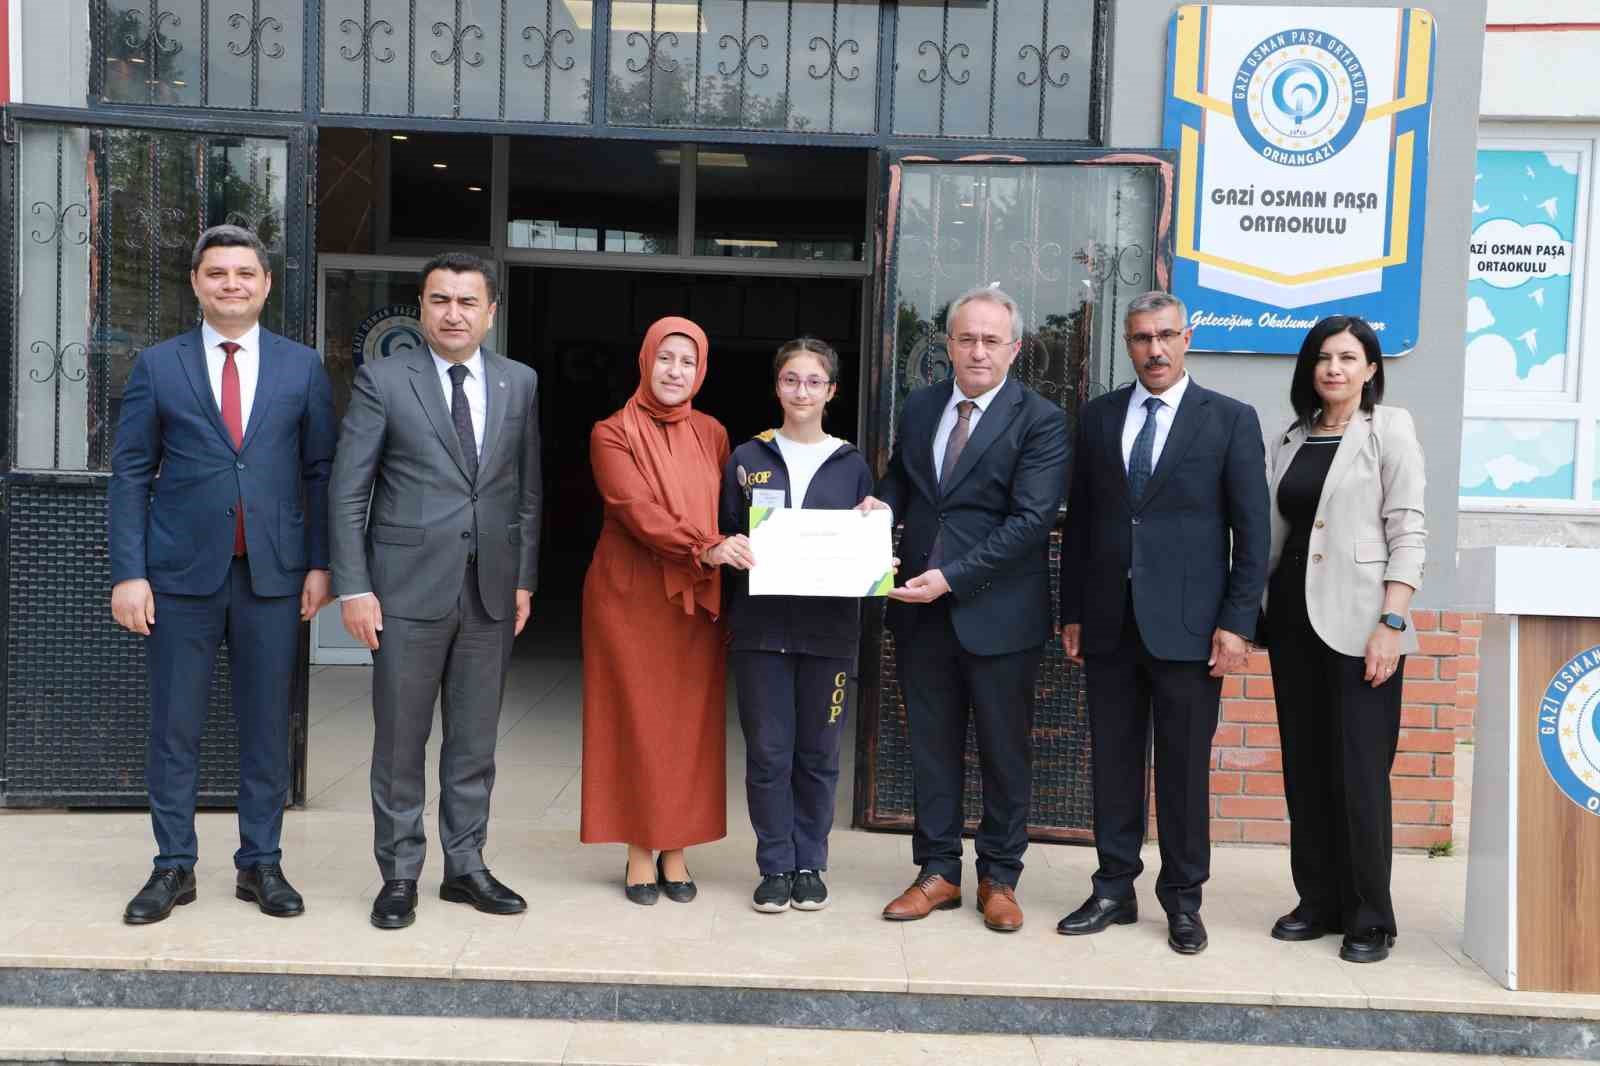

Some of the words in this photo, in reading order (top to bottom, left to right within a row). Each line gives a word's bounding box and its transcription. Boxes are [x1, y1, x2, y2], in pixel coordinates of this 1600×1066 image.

[1247, 35, 1286, 66] OSMAN
[1291, 31, 1322, 47] PAŞA
[1327, 39, 1367, 104] ORTAOKULU
[1263, 142, 1336, 165] ORHANGAZİ
[1211, 184, 1254, 208] GAZİ
[1261, 189, 1327, 208] OSMAN
[1333, 191, 1378, 213] PAŞA
[1239, 215, 1347, 235] ORTAOKULU
[1470, 241, 1487, 255] AZİ
[1491, 243, 1532, 256] OSMAN
[1536, 245, 1565, 260] PAŞA
[1477, 261, 1547, 273] ORTAOKULU
[1190, 310, 1254, 331] Geleceğim
[1258, 312, 1320, 329] Okulumd
[747, 470, 772, 486] GOP
[828, 672, 846, 723] GOP
